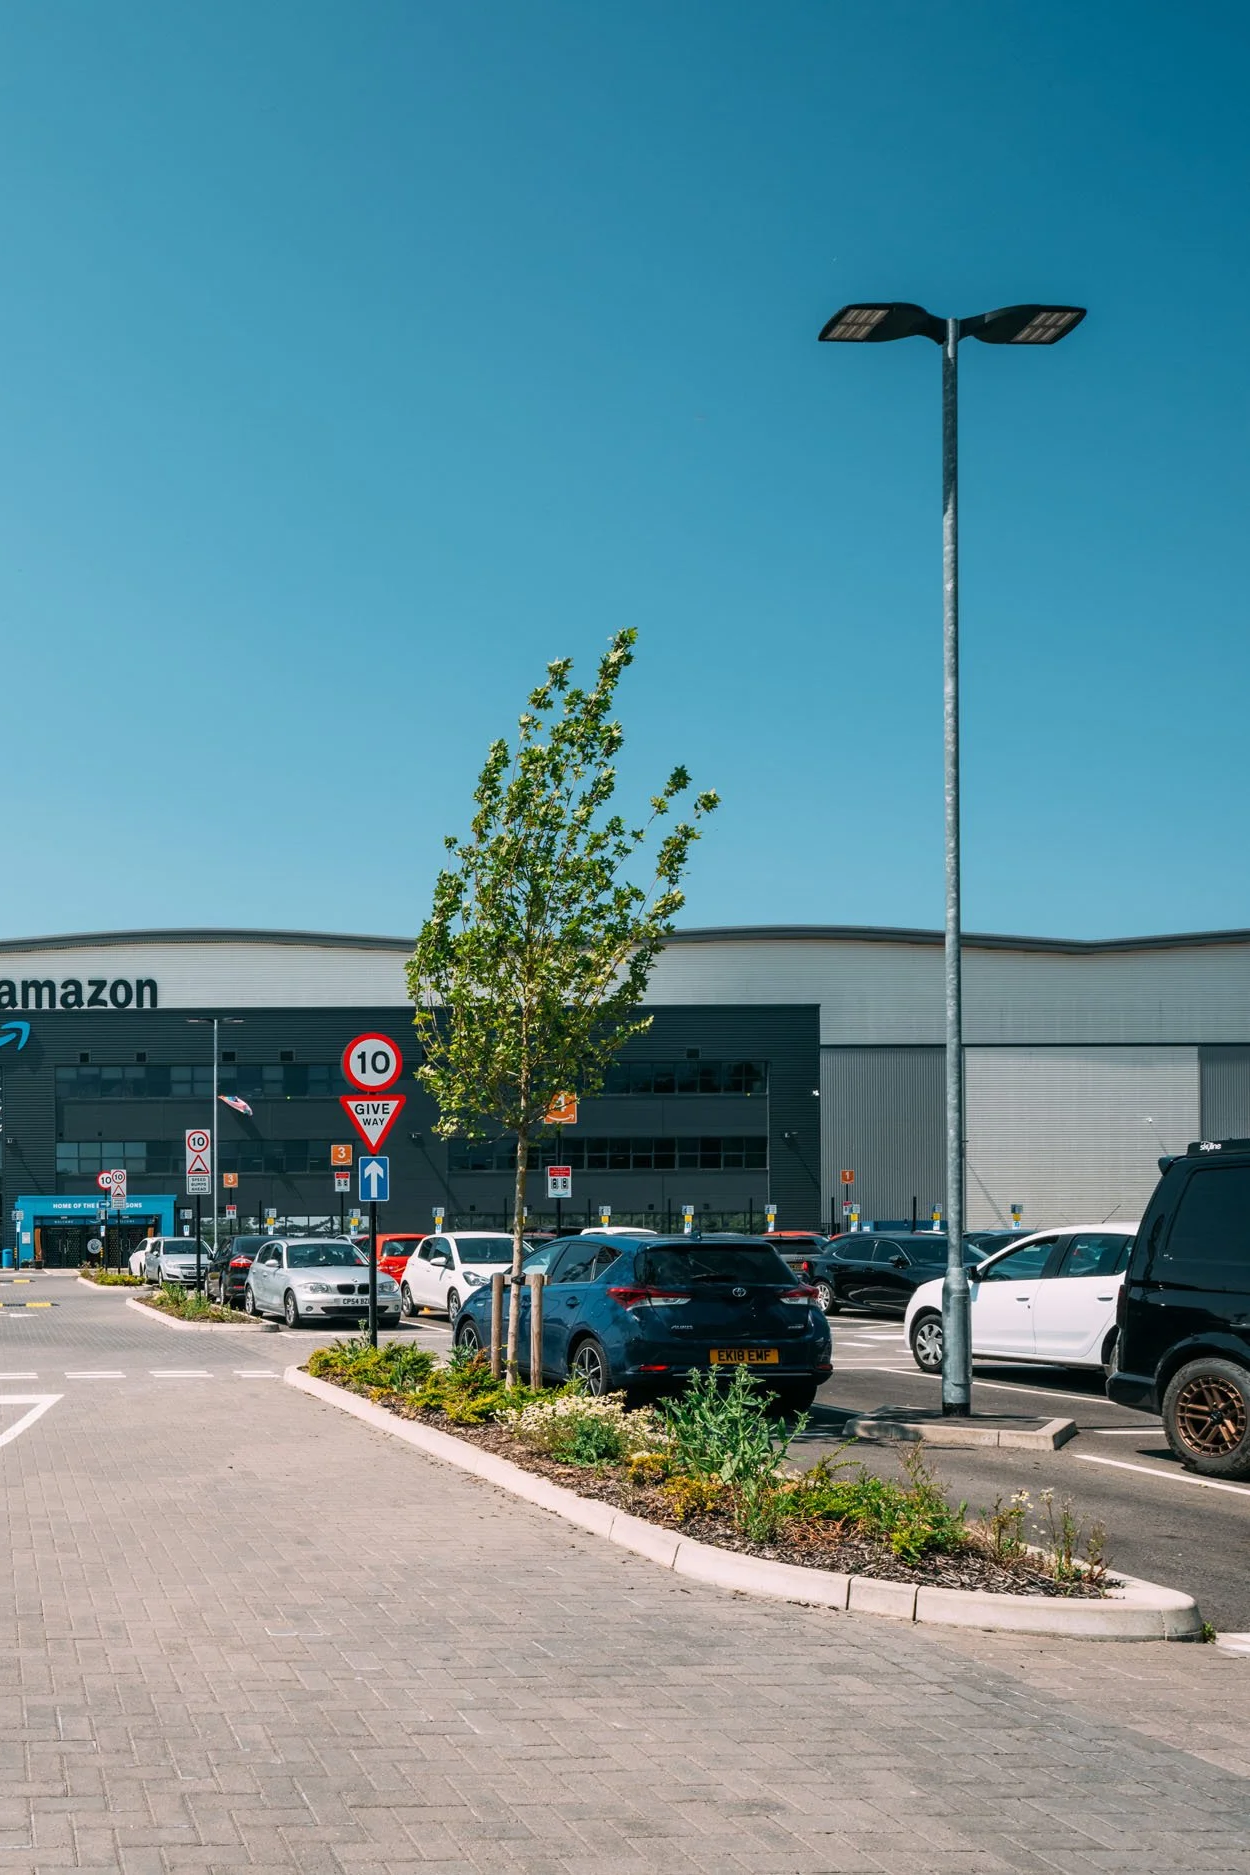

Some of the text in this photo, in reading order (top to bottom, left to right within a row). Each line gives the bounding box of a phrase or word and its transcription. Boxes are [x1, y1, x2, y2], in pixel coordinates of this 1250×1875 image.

[357, 1050, 391, 1075] 10
[354, 1103, 390, 1115] GIVE
[362, 1118, 385, 1126] WAY
[191, 1137, 205, 1146] 10
[337, 1146, 346, 1159] 3
[101, 1176, 111, 1185] 10
[228, 1174, 234, 1183] 3
[717, 1350, 771, 1361] EK18 EMF
